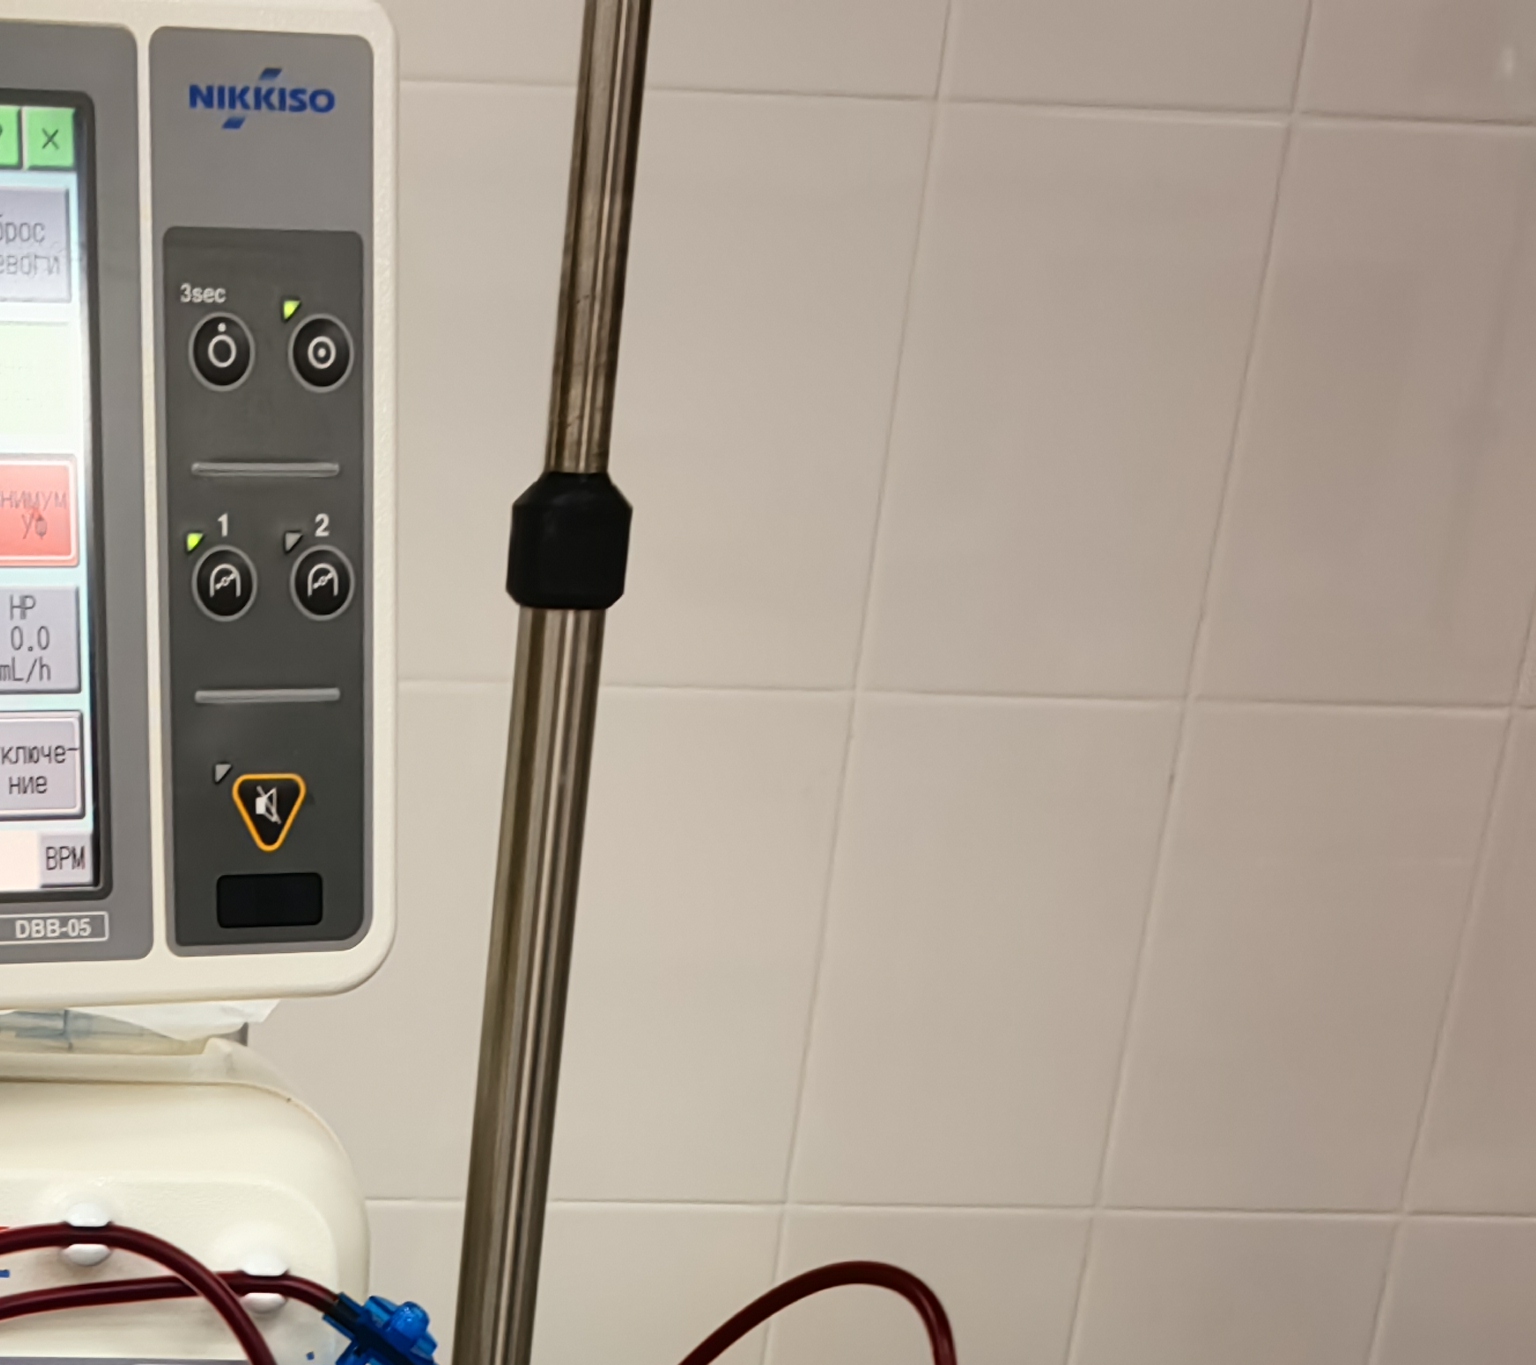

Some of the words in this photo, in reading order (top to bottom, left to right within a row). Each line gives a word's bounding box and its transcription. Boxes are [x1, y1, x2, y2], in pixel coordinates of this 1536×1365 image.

[189, 84, 335, 113] NIKKISO
[180, 283, 227, 303] 3sec
[217, 513, 228, 535] 1
[314, 514, 330, 536] 2
[10, 626, 51, 652] 0.0
[8, 773, 48, 796] ние
[15, 919, 92, 939] DBB-05
